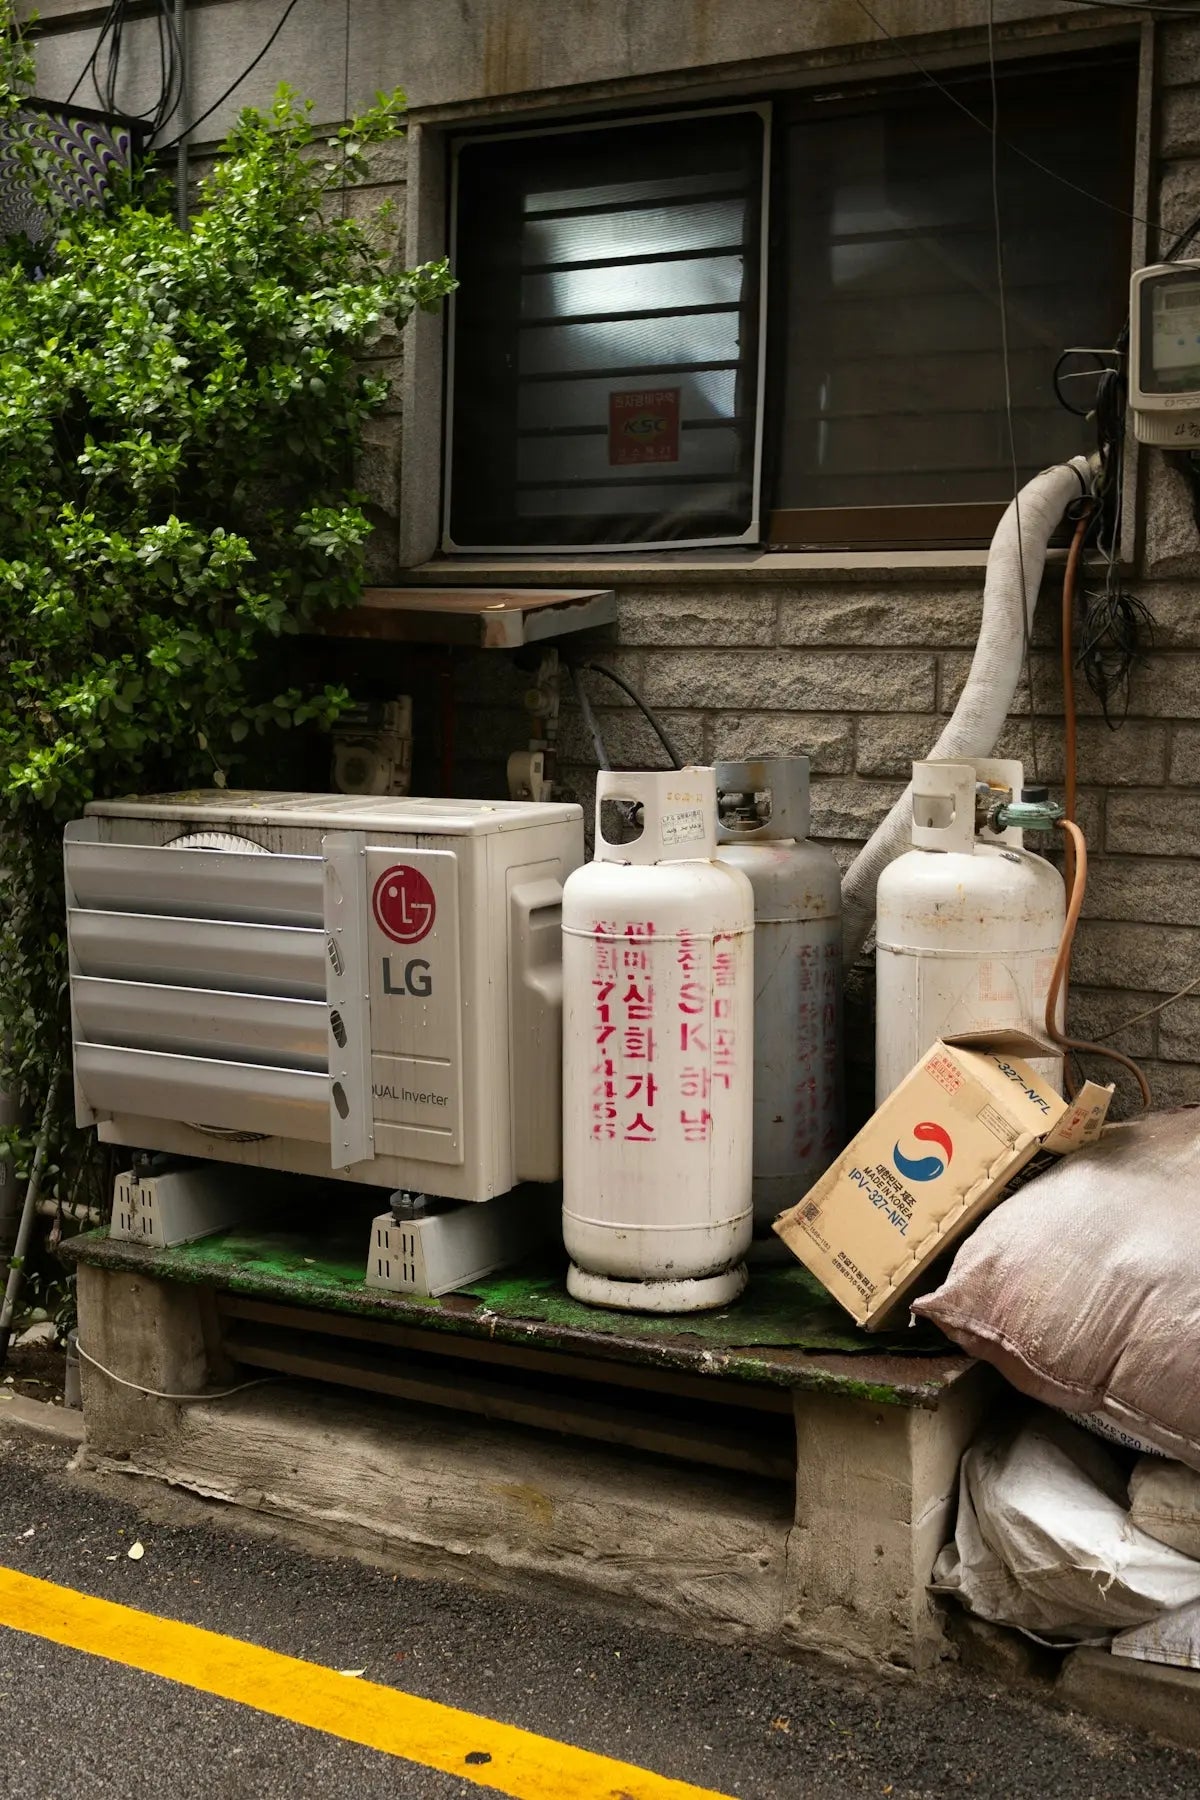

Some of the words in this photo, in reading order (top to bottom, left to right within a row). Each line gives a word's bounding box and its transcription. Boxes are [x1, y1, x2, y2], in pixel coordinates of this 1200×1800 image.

[382, 956, 433, 997] LG
[401, 1087, 449, 1107] Inverter
[848, 1167, 909, 1237] IPV-327-NFL
[863, 1166, 885, 1190] MADE
[881, 1186, 892, 1197] IN
[888, 1193, 913, 1220] KOREA
[876, 1164, 903, 1193] 대한민국
[900, 1190, 917, 1208] 제조
